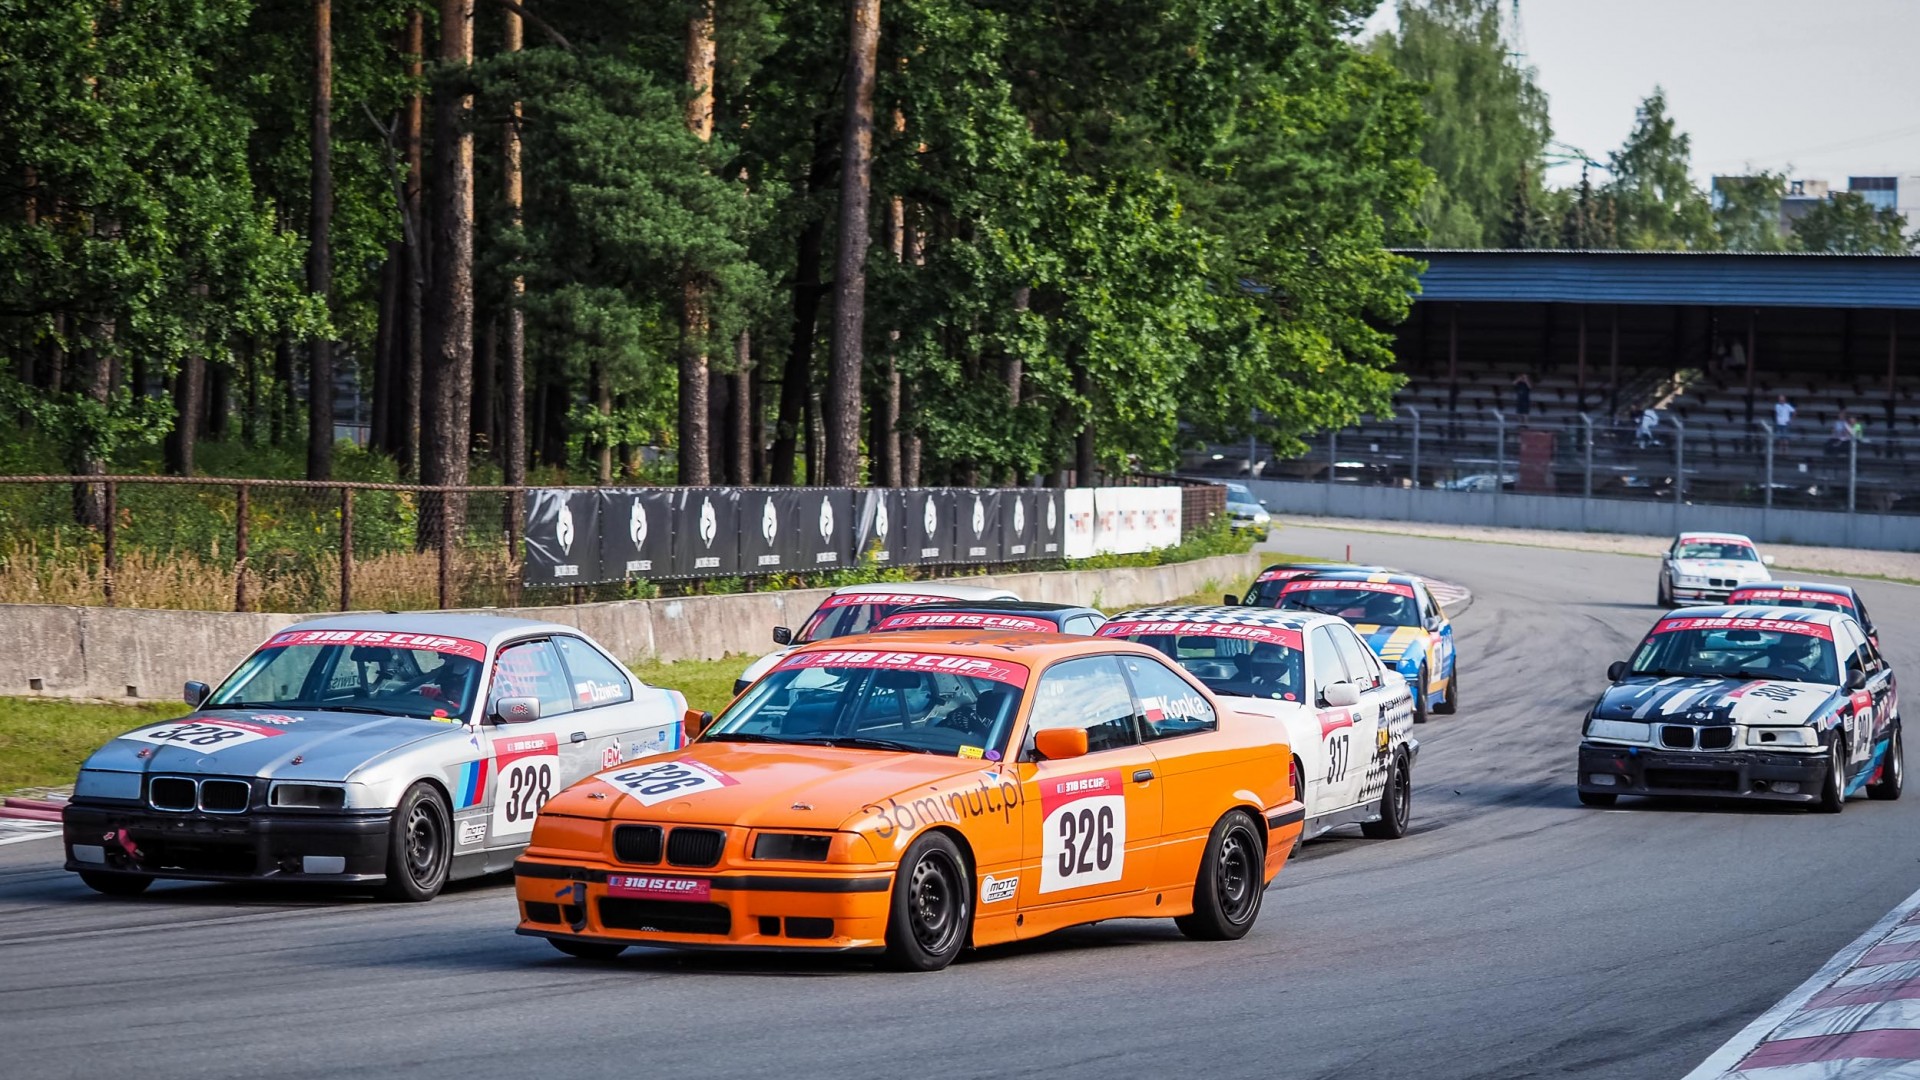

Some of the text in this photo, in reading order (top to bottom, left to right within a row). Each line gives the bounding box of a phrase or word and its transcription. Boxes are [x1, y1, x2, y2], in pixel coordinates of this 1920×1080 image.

[1308, 580, 1397, 591] 318 IS CUP
[853, 595, 890, 603] 318
[914, 615, 954, 624] 318
[955, 615, 982, 626] IS
[982, 616, 1036, 628] CUP
[1690, 618, 1729, 627] 318
[1759, 621, 1811, 631] CUP
[301, 631, 350, 641] 318
[353, 631, 388, 642] IS
[389, 633, 457, 647] CUP
[1132, 623, 1179, 632] 318
[1179, 623, 1212, 632] IS
[1211, 624, 1272, 638] CUP
[818, 651, 871, 664] 318
[878, 653, 918, 665] IS
[915, 655, 993, 671] CUP
[587, 679, 623, 701] Dziwisz
[1750, 684, 1805, 701] 304
[1157, 692, 1206, 723] Kopka
[148, 723, 245, 746] 328
[1327, 734, 1349, 785] 317
[614, 764, 706, 795] 326
[1065, 780, 1079, 792] 318
[1079, 779, 1088, 790] IS
[1088, 777, 1105, 789] CUP
[506, 763, 552, 823] 328
[861, 769, 1025, 839] 36minut.pl
[1058, 805, 1114, 878] 326
[624, 877, 648, 888] 318
[648, 878, 665, 889] IS
[665, 880, 698, 890] CUP
[989, 878, 1018, 891] MOTO
